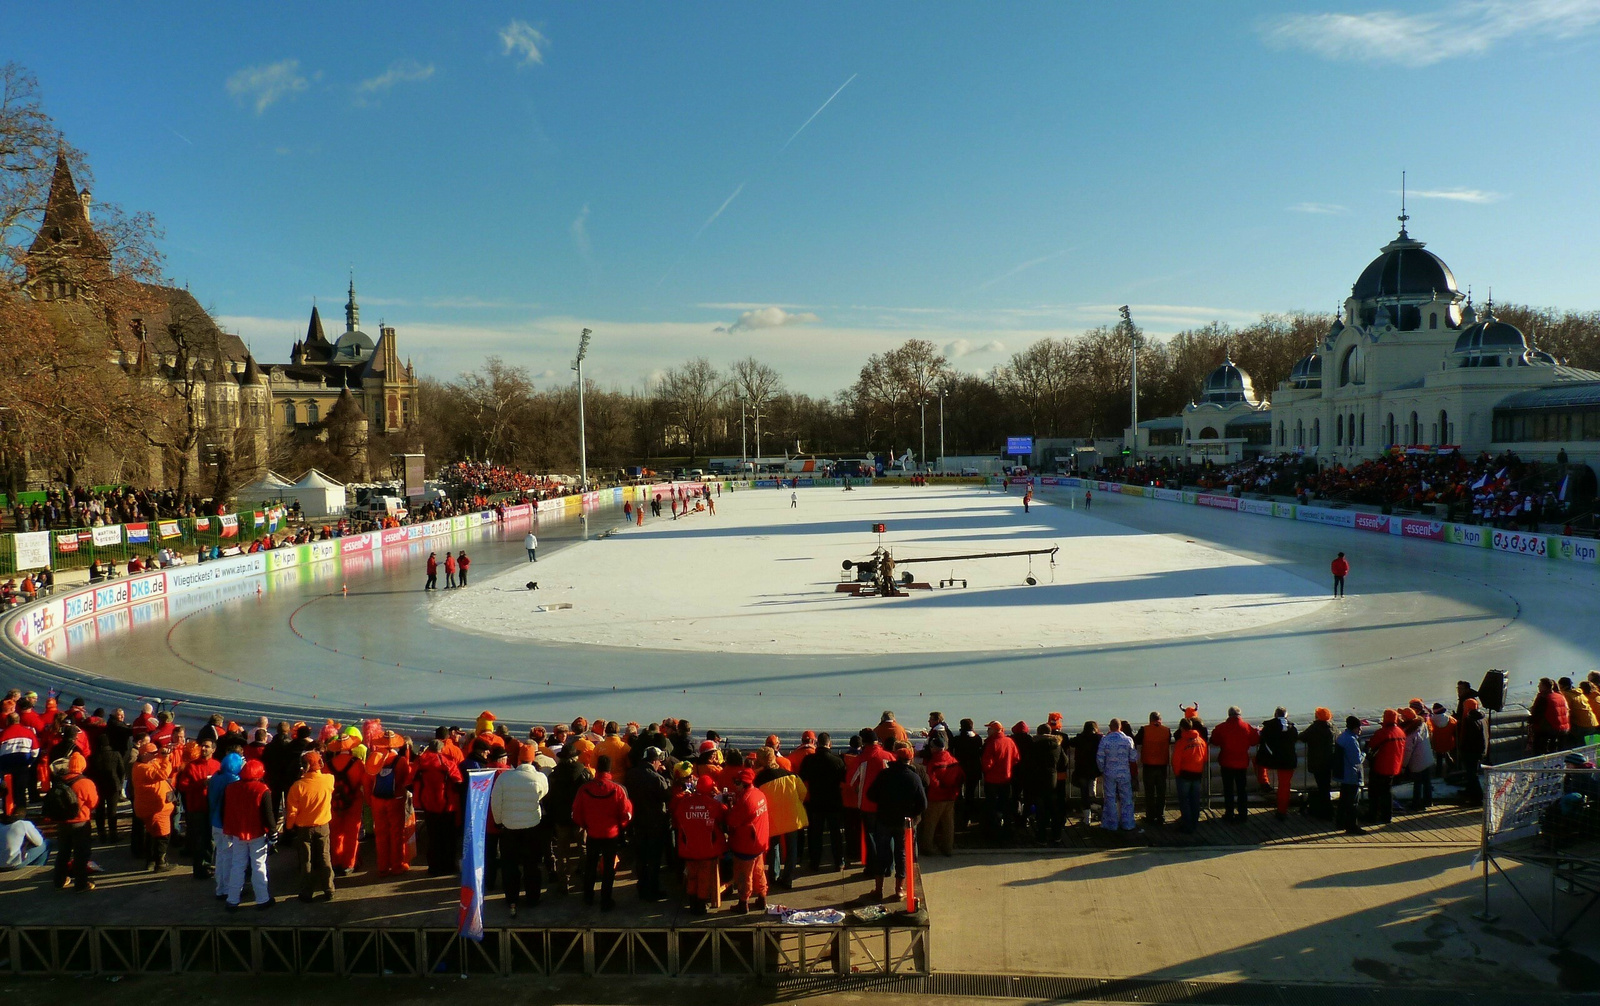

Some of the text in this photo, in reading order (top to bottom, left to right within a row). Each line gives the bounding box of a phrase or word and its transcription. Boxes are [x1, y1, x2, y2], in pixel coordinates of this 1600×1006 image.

[1357, 518, 1379, 528] essent
[1405, 524, 1432, 536] essent
[1464, 529, 1480, 542] kpn
[322, 545, 333, 558] kpn
[342, 540, 364, 552] essent
[1575, 544, 1595, 560] kpn
[282, 550, 296, 564] kpn
[173, 560, 254, 587] Vliegtickets? www.atp.nl
[131, 579, 163, 598] DKB.de
[96, 585, 127, 608] DKB.de
[66, 596, 94, 619] DKB.de
[33, 608, 54, 634] FedEx
[686, 810, 710, 820] UNIVÉ
